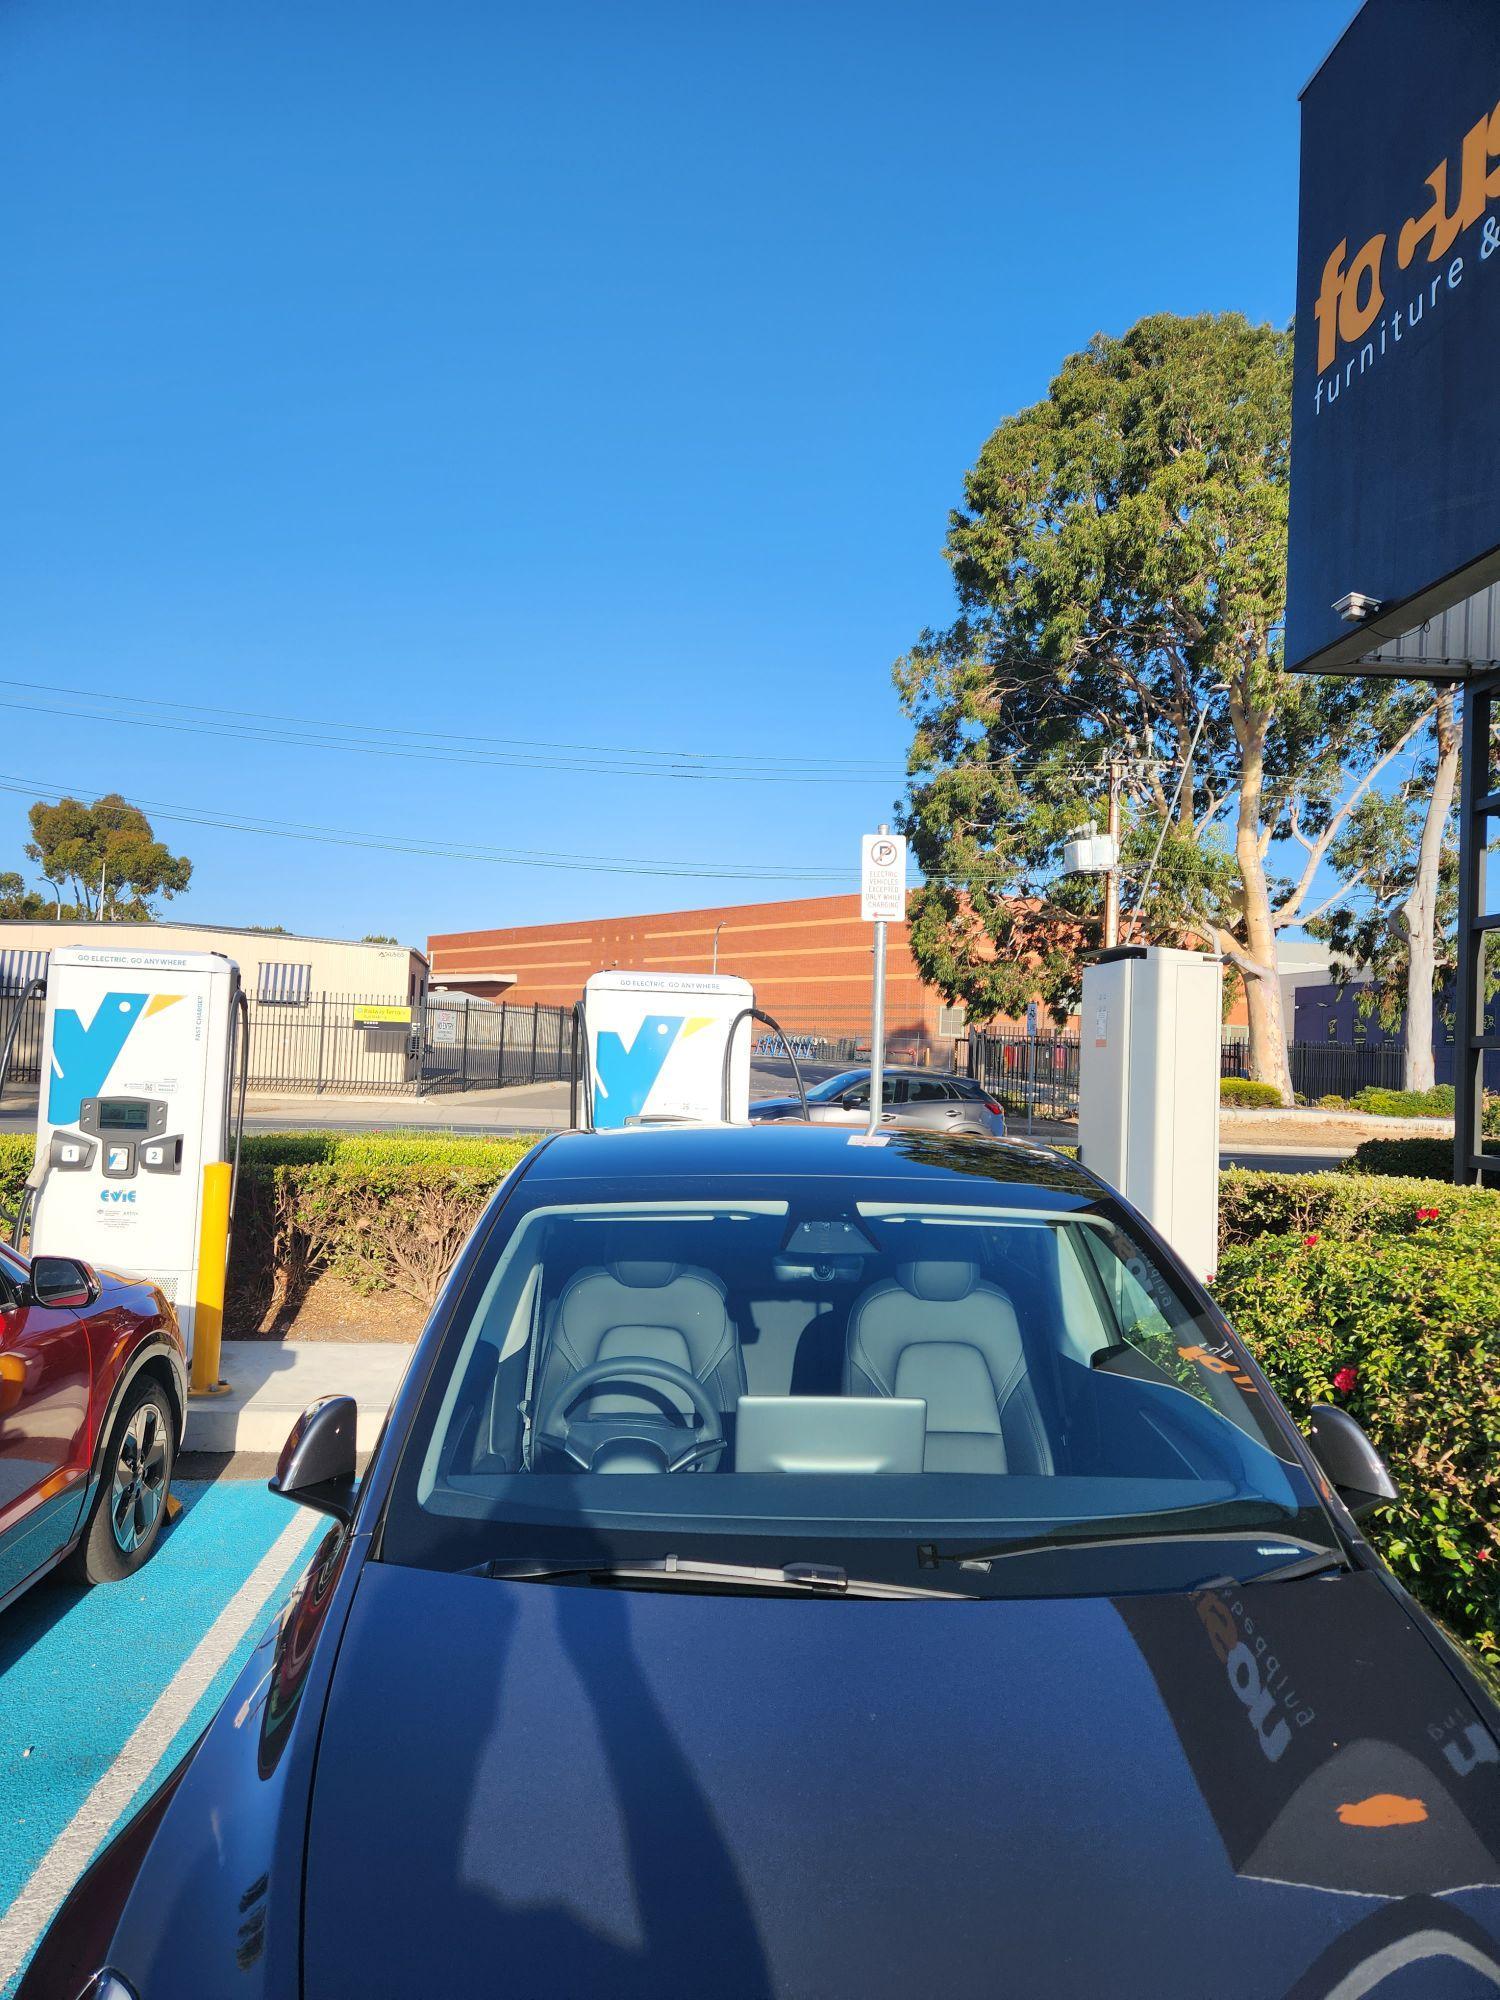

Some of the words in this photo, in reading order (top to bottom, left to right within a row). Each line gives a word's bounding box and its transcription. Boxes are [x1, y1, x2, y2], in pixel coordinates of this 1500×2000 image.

[1314, 257, 1464, 415] furniture
[1480, 216, 1500, 260] &
[144, 958, 187, 966] ANYWHERE
[68, 1149, 73, 1158] 1
[151, 1151, 158, 1160] 2
